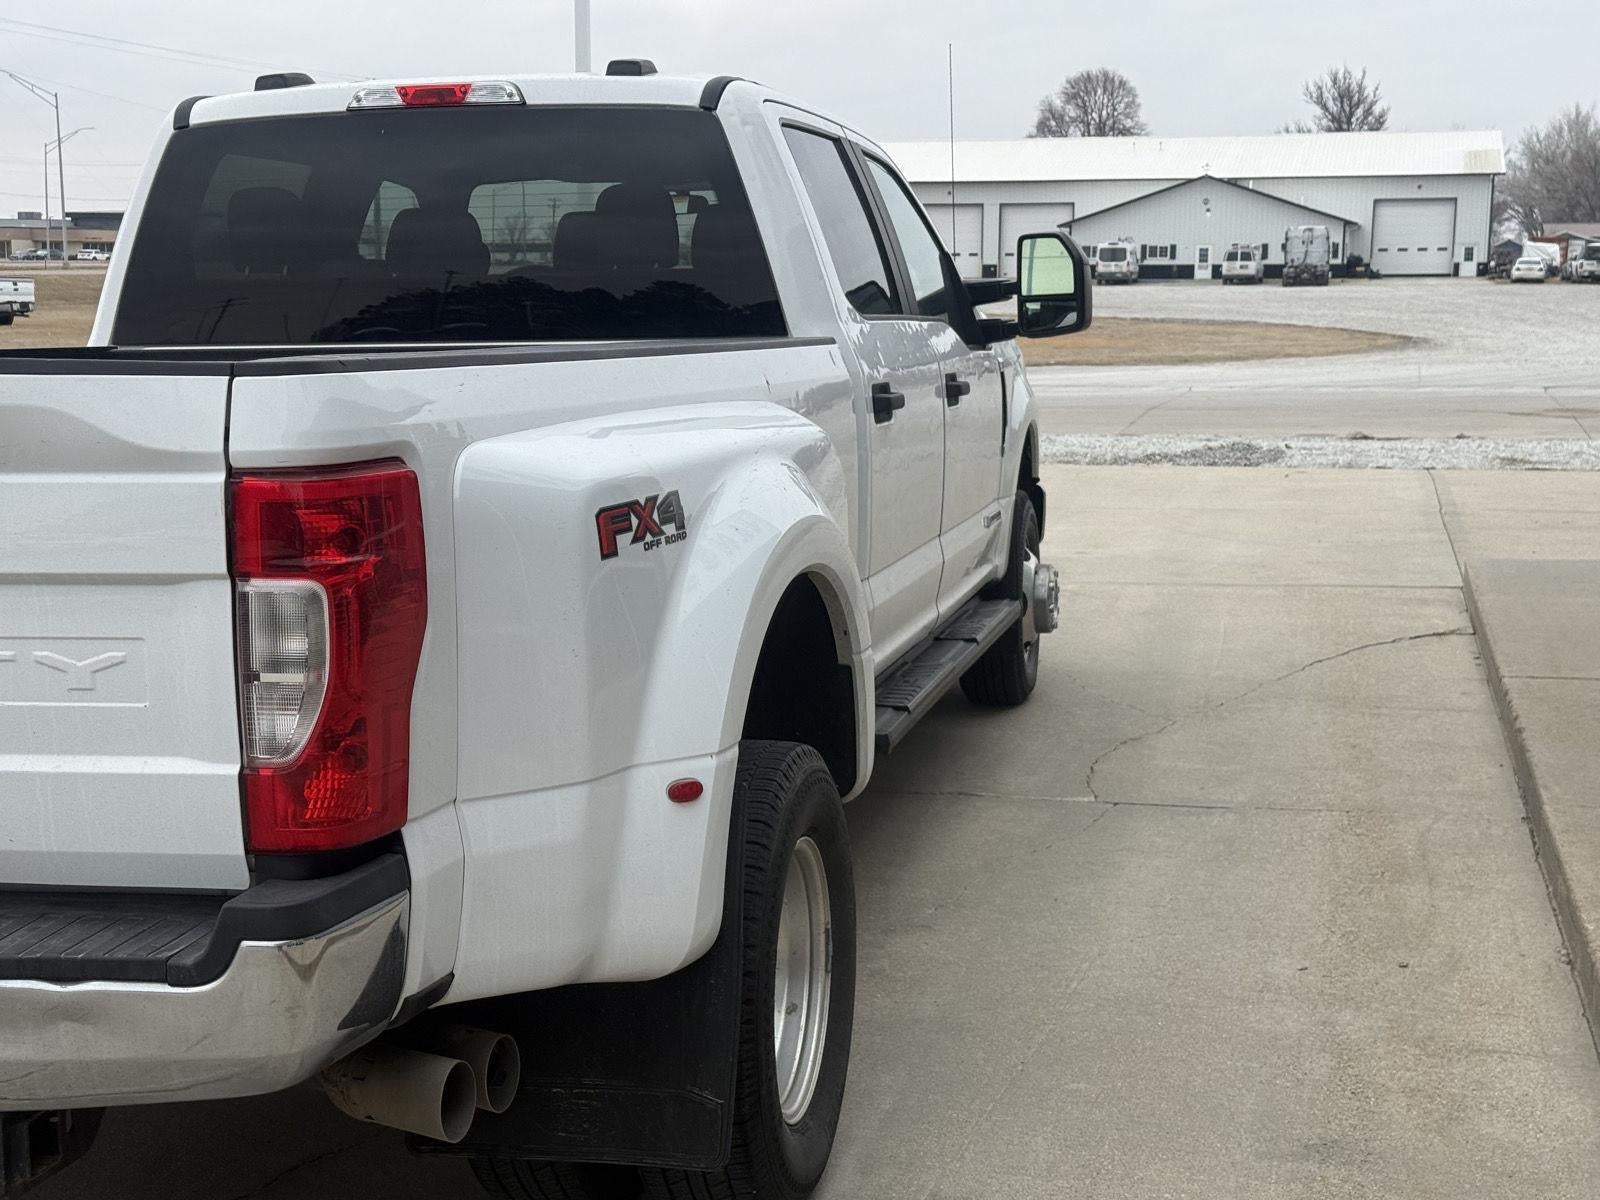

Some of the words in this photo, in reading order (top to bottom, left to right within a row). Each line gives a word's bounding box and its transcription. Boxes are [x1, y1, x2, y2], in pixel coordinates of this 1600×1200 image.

[595, 490, 686, 561] FX4
[643, 539, 663, 552] OFF
[664, 531, 687, 546] ROAD
[0, 650, 127, 692] Y
